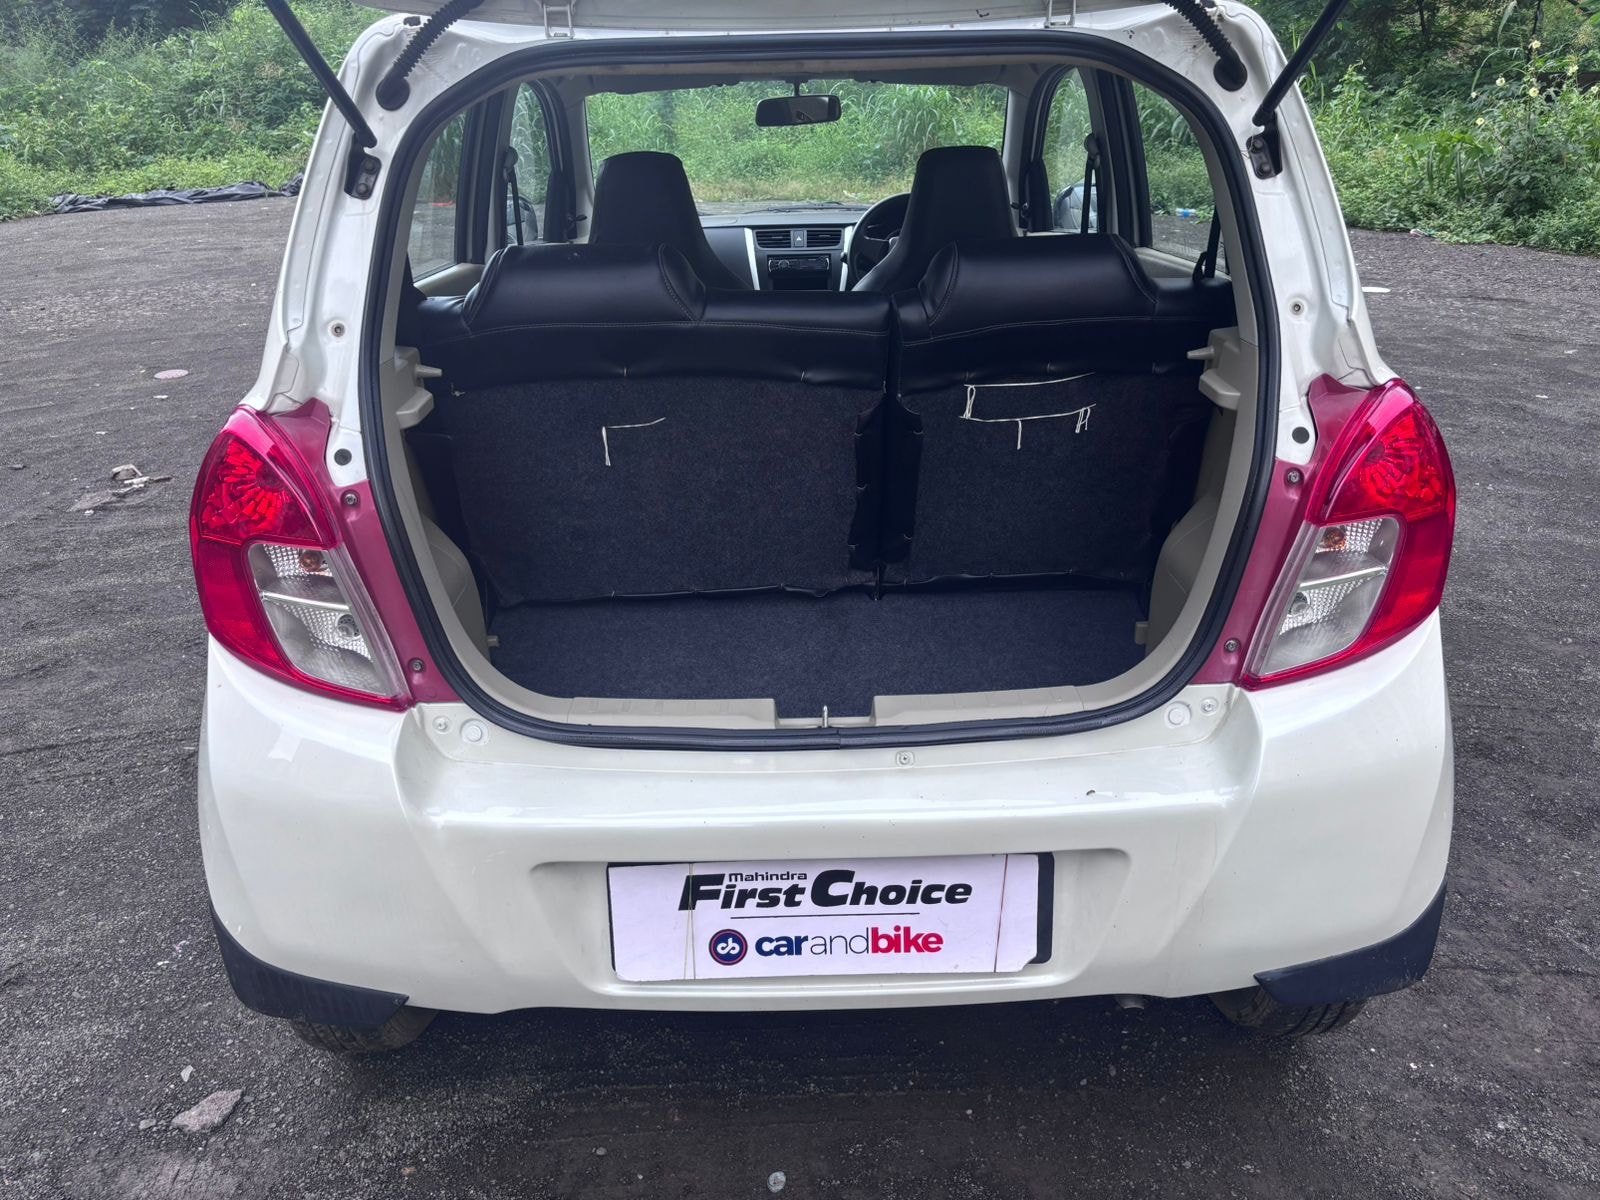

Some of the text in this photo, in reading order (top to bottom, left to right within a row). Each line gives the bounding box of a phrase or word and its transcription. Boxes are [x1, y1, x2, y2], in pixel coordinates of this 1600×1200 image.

[728, 871, 808, 882] Mahindra
[677, 869, 972, 911] First Choice
